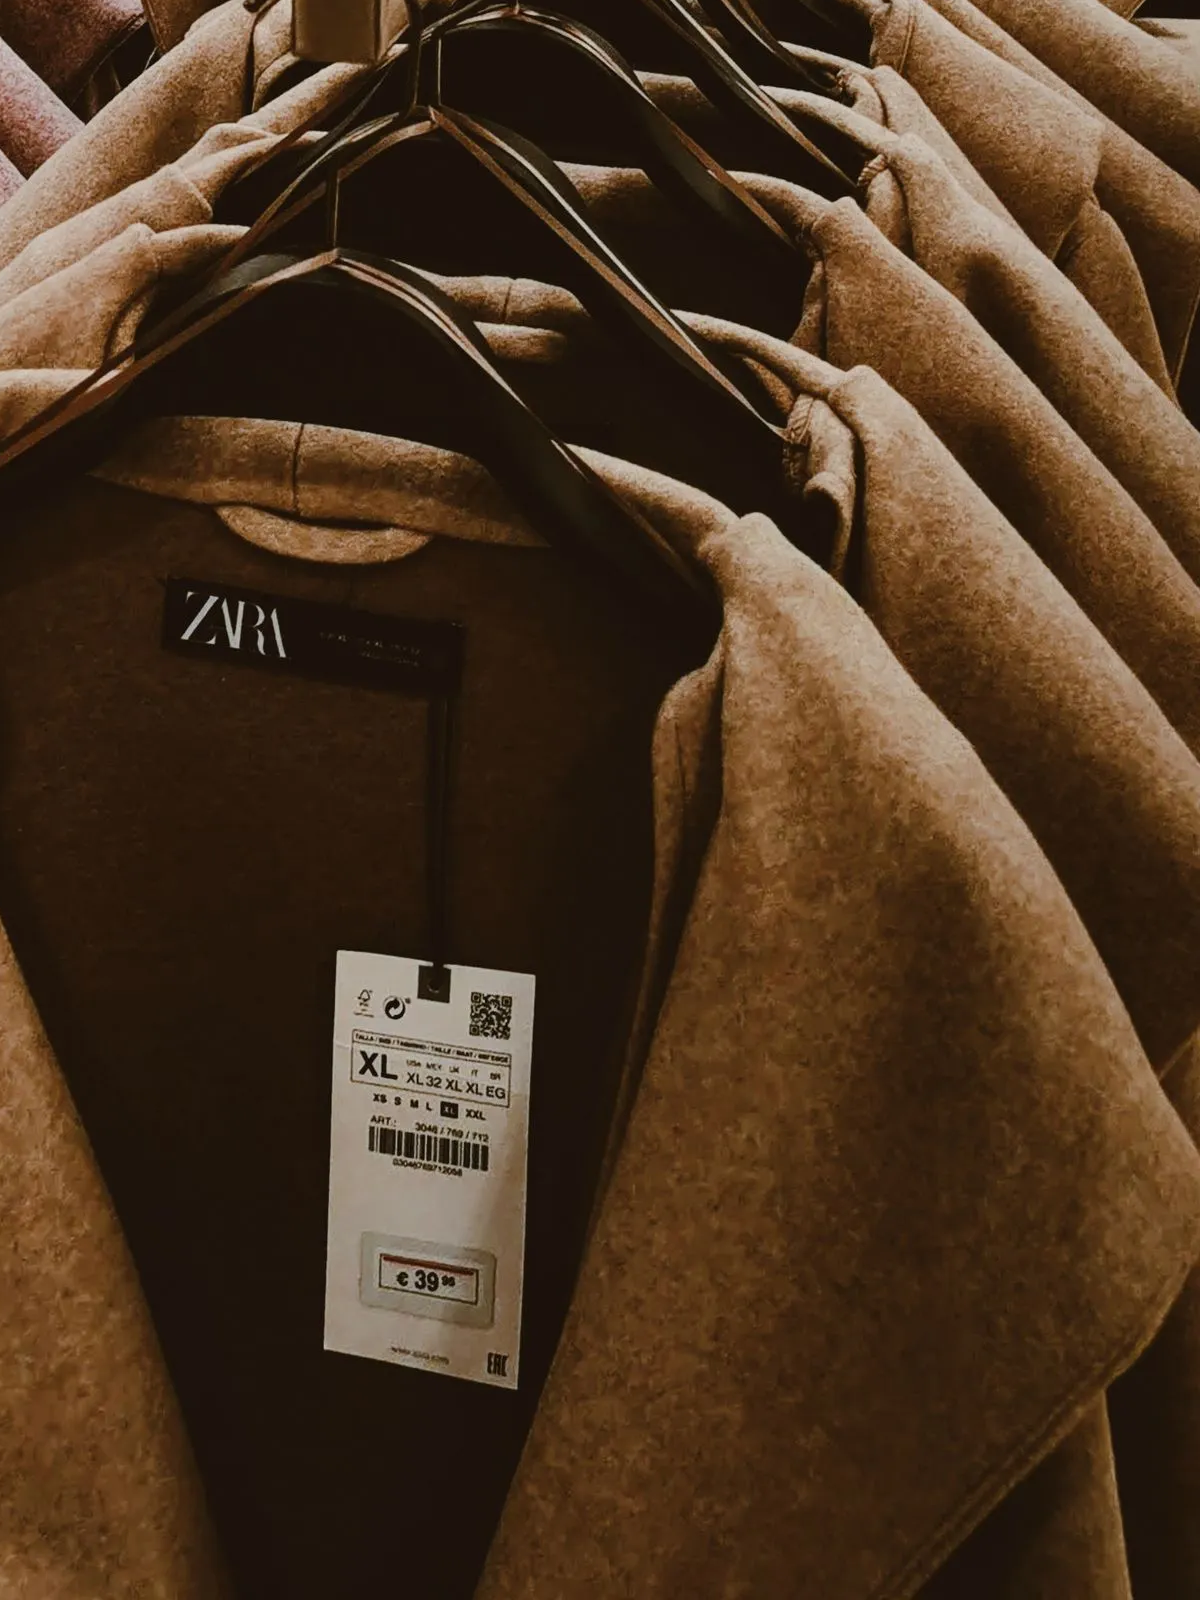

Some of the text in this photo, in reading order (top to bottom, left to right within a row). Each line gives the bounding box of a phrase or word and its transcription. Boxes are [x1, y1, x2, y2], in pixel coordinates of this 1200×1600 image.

[180, 589, 292, 659] ZARA
[358, 1050, 398, 1080] XL
[406, 1072, 506, 1099] XL 32 XL XL EG
[372, 1093, 486, 1120] XS S M L XL XXL
[396, 1271, 409, 1287] €
[414, 1269, 439, 1292] 39
